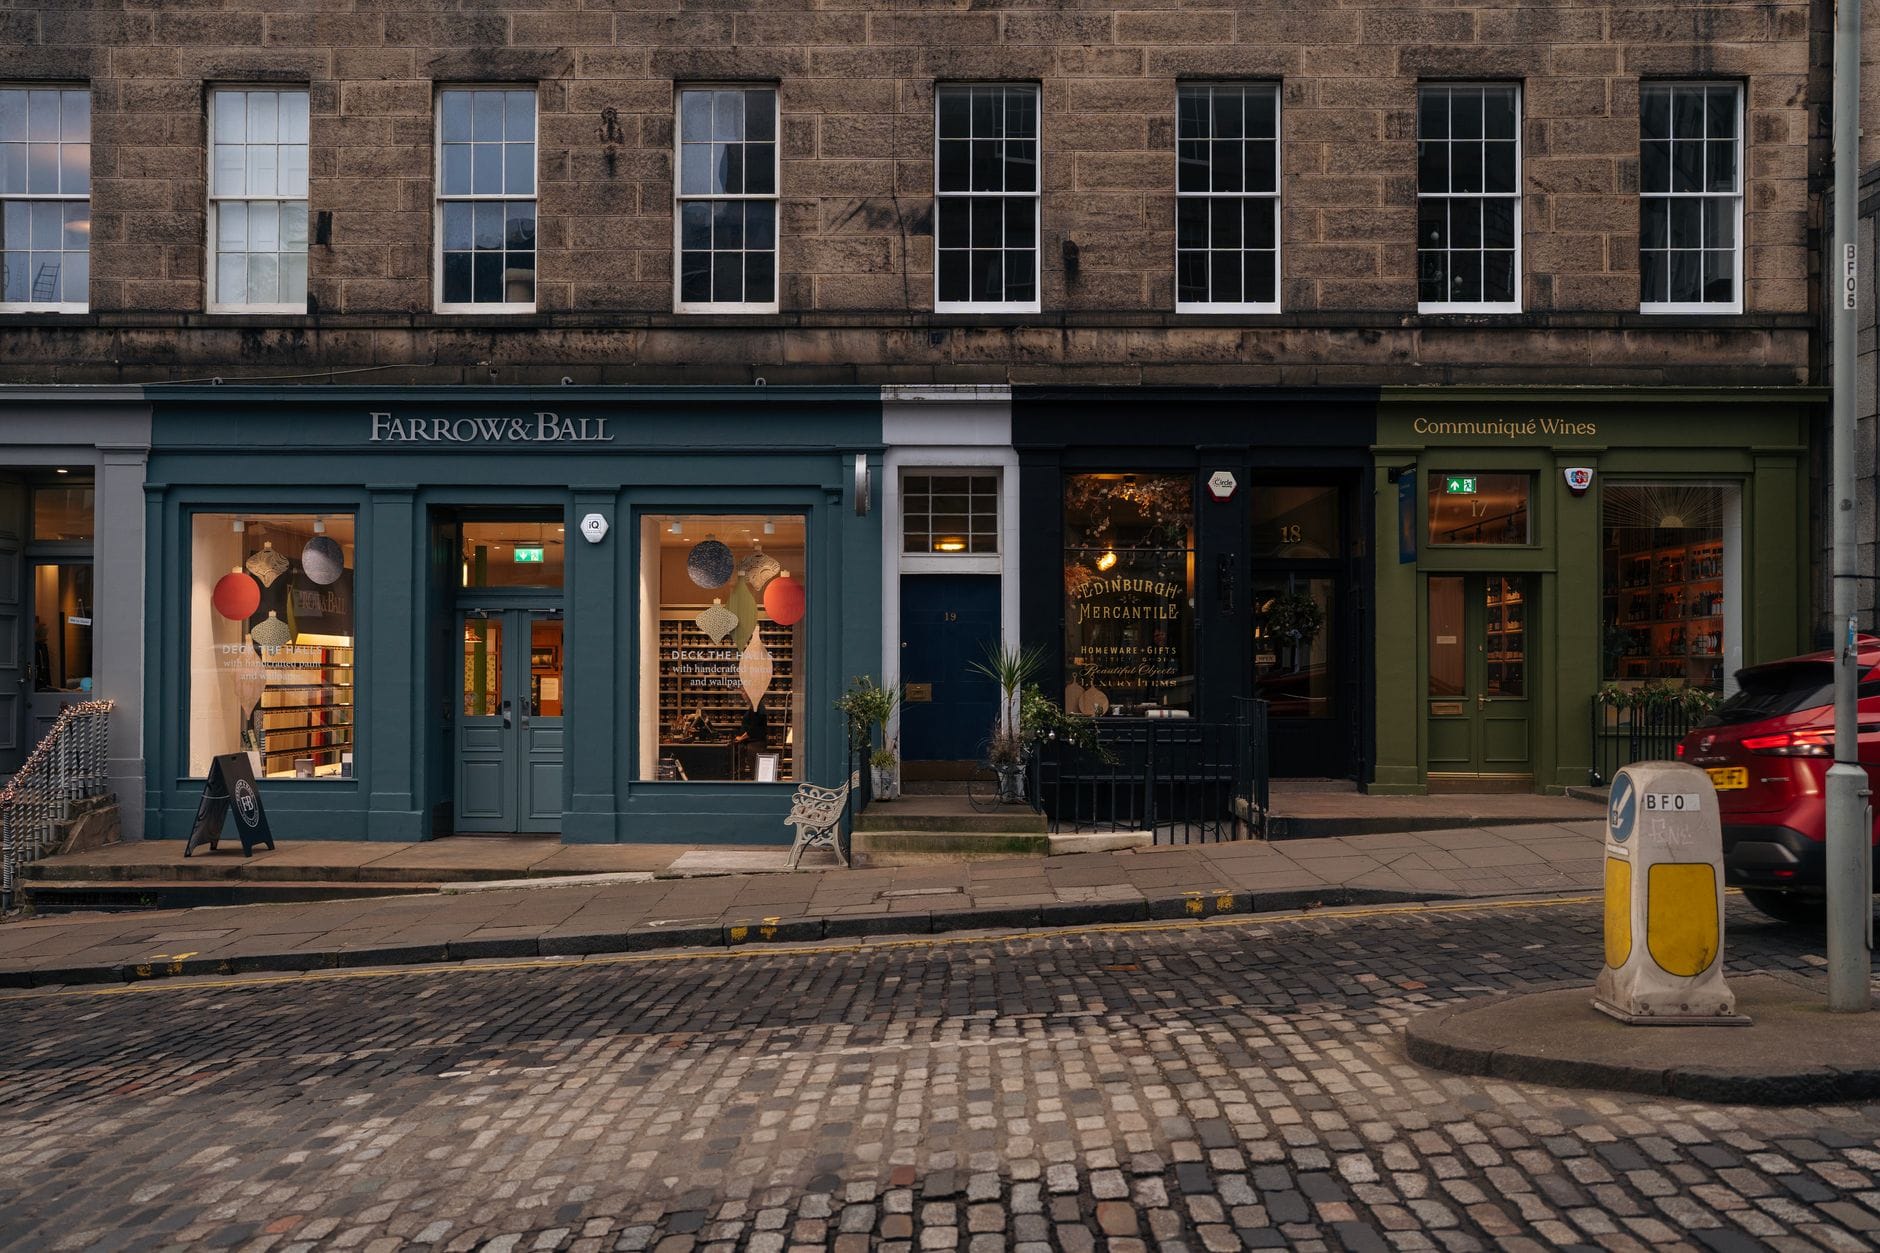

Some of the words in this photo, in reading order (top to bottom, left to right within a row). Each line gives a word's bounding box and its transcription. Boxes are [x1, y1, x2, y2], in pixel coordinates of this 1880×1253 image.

[1413, 417, 1537, 438] Communiqué
[1539, 418, 1596, 435] Wines
[588, 520, 600, 530] iQ
[1280, 525, 1302, 543] 18
[1080, 579, 1178, 599] EDINBURGH
[945, 611, 957, 621] 19
[1078, 603, 1179, 624] MERCANTILE
[671, 650, 705, 660] DECK
[708, 650, 732, 660] THE
[1081, 646, 1137, 654] HOMEWARE
[1147, 646, 1177, 654] GIFTS
[673, 664, 690, 673] with
[690, 676, 707, 686] and
